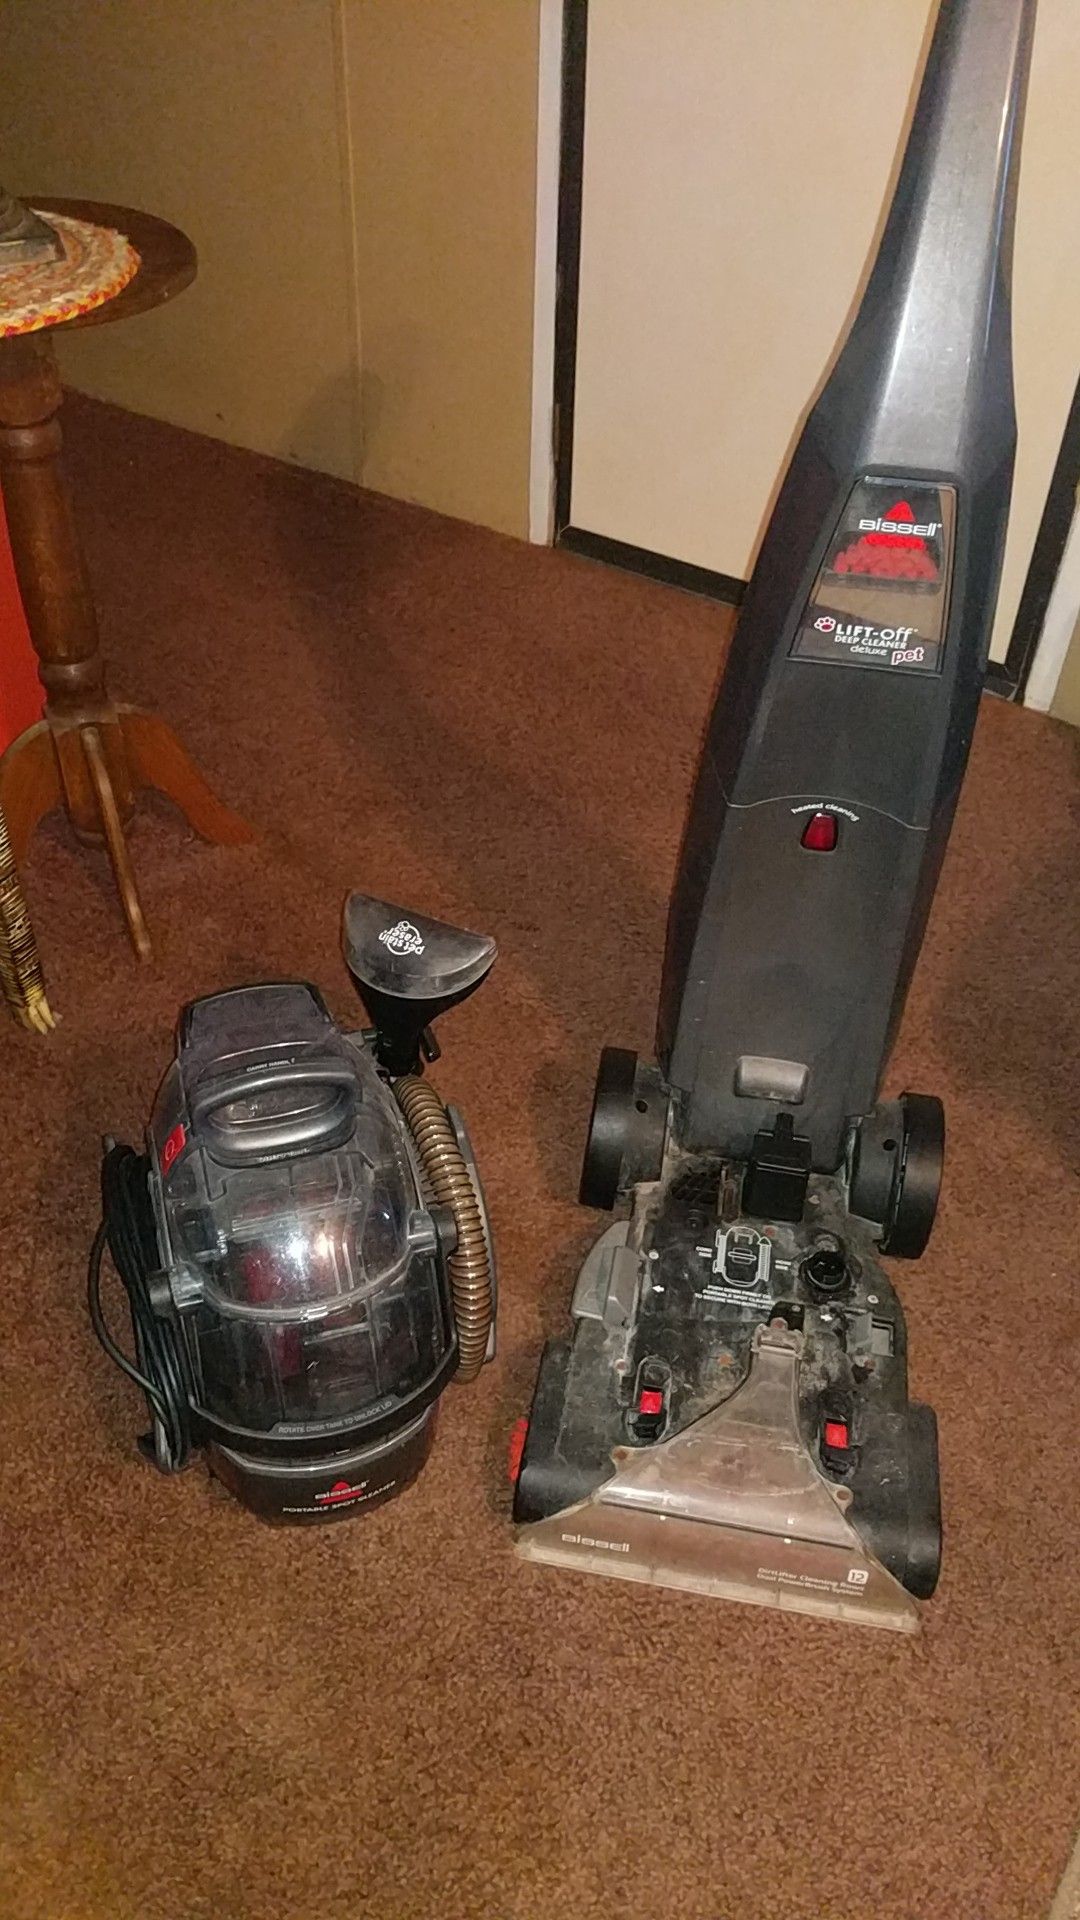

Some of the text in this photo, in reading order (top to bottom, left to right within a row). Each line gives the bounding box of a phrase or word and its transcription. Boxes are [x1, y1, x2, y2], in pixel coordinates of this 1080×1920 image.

[834, 635, 907, 649] DEEP CLEANER
[850, 645, 888, 656] deluxe
[891, 647, 924, 665] pet
[790, 802, 860, 821] heated cleaning
[378, 930, 425, 955] pet stain
[387, 928, 423, 945] eraser
[331, 1499, 355, 1510] SPOT
[357, 1480, 396, 1502] CLEANER
